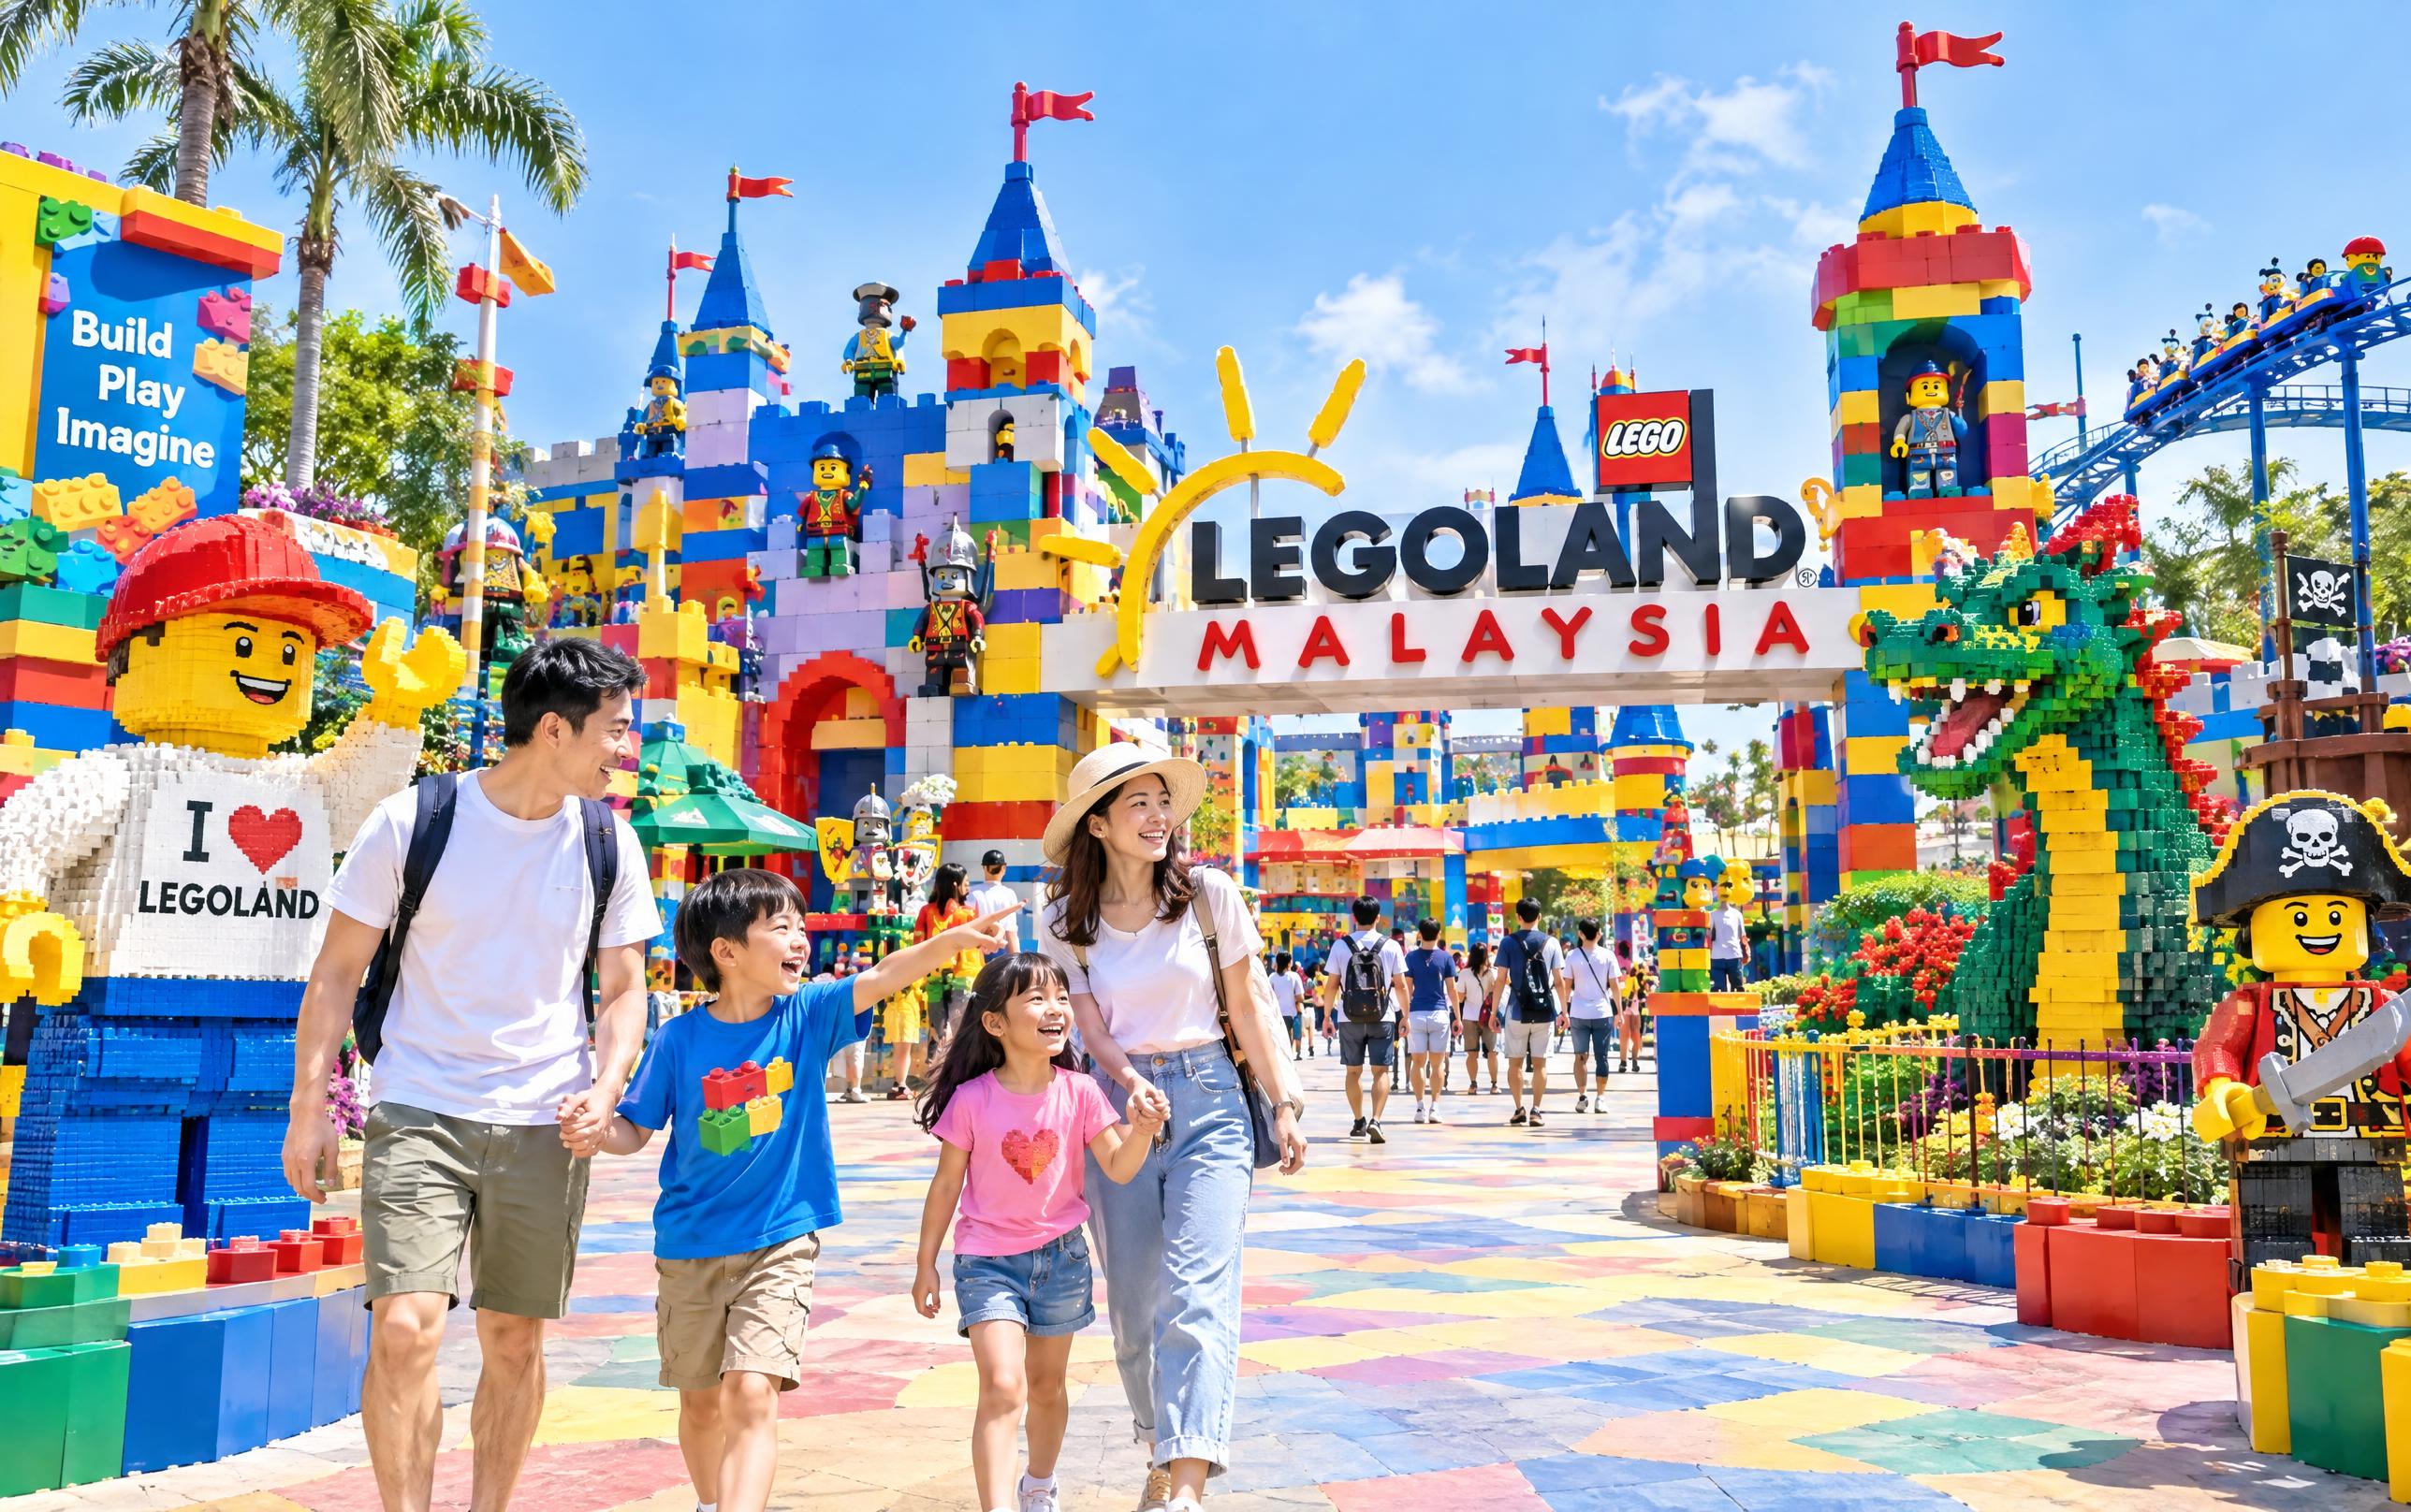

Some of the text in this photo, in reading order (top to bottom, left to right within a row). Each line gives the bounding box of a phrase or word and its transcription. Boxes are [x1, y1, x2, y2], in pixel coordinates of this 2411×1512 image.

[71, 309, 173, 359] Build
[97, 363, 186, 420] Play
[56, 406, 216, 469] Imagine
[1604, 420, 1685, 457] LEGO
[1191, 493, 1806, 603] LEGOLAND
[1197, 601, 1810, 672] MALAYSIA
[183, 800, 213, 863] I
[138, 880, 320, 920] LEGOLAND
